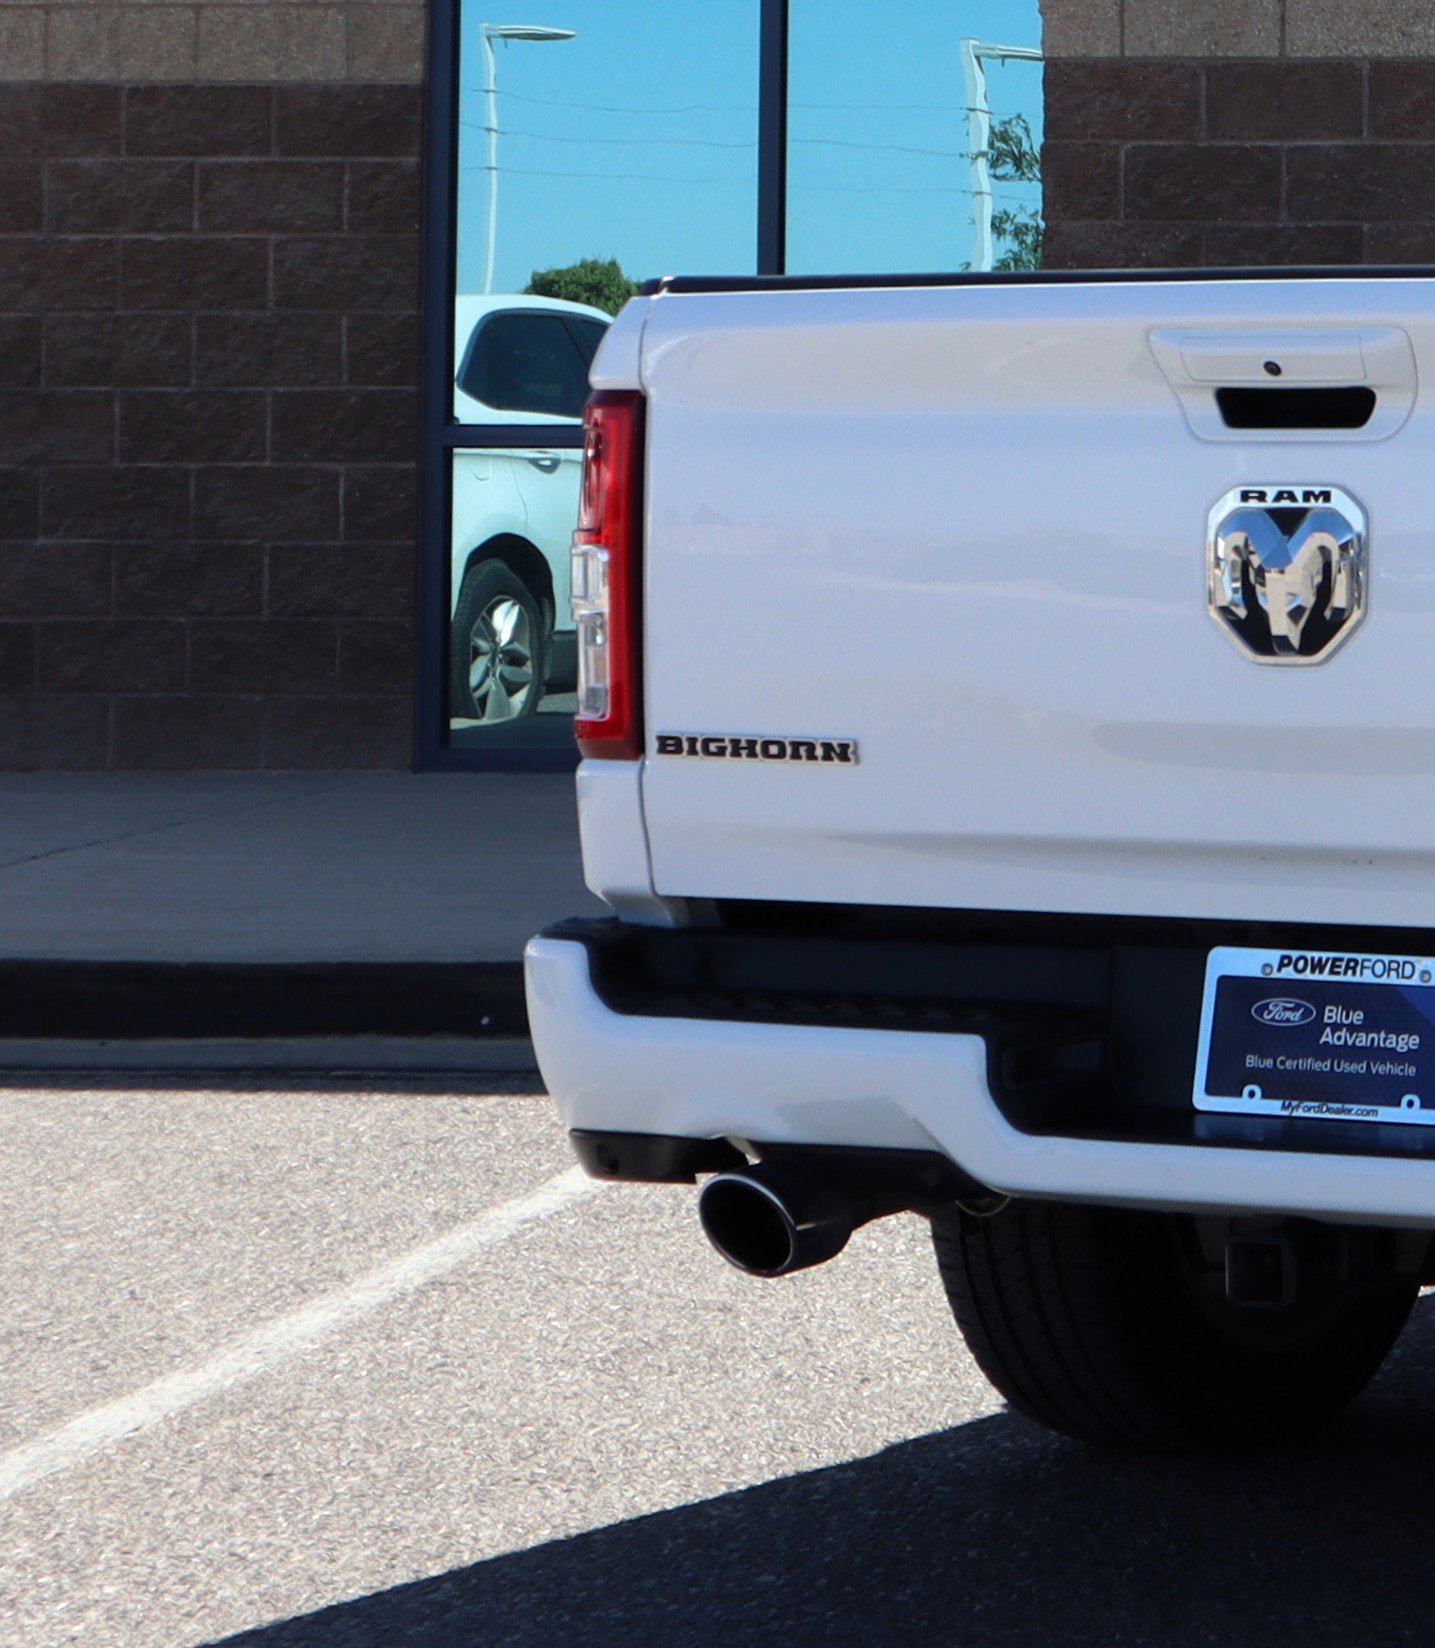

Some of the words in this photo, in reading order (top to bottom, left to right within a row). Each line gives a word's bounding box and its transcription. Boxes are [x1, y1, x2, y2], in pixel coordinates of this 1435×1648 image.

[1239, 489, 1332, 504] RAM
[655, 734, 854, 763] BIGHORN
[1276, 954, 1416, 980] POWERFORD
[1262, 1001, 1303, 1023] Ford
[1323, 1005, 1365, 1026] Blue
[1318, 1026, 1421, 1053] Advantage
[1244, 1054, 1274, 1069] Blue
[1276, 1055, 1331, 1072] Certified
[1333, 1059, 1367, 1074] Used
[1369, 1060, 1417, 1077] Vehicle
[1279, 1100, 1379, 1118] MyFordDealer.com
